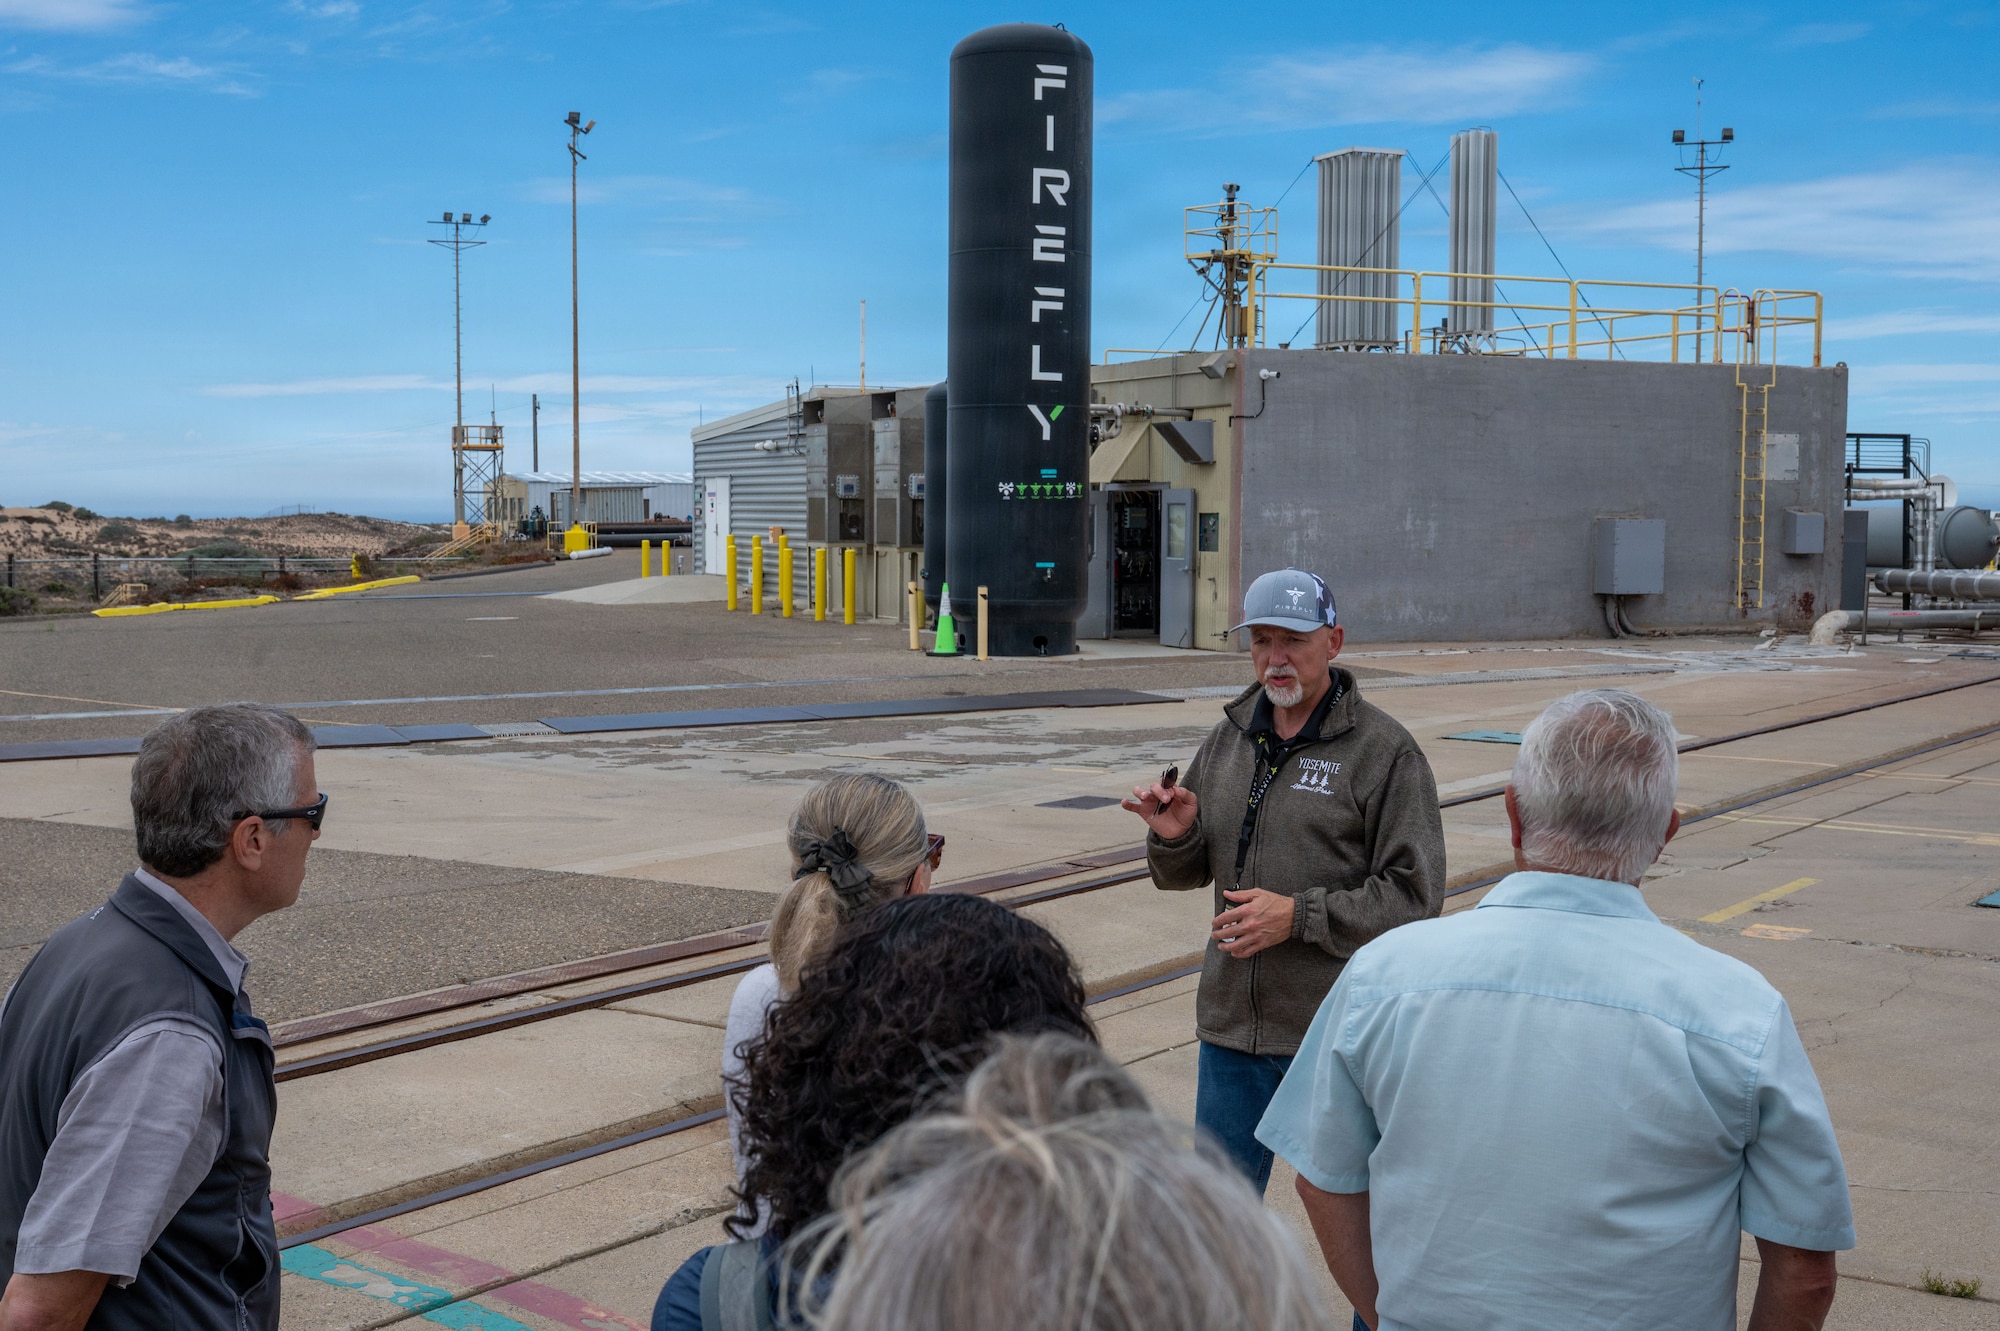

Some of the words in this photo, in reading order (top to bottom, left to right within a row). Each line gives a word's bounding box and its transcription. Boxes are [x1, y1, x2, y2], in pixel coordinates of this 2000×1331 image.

[1028, 64, 1070, 441] FIREFLY
[1274, 604, 1313, 613] FIREFLY
[1298, 757, 1342, 775] YOSEMITE
